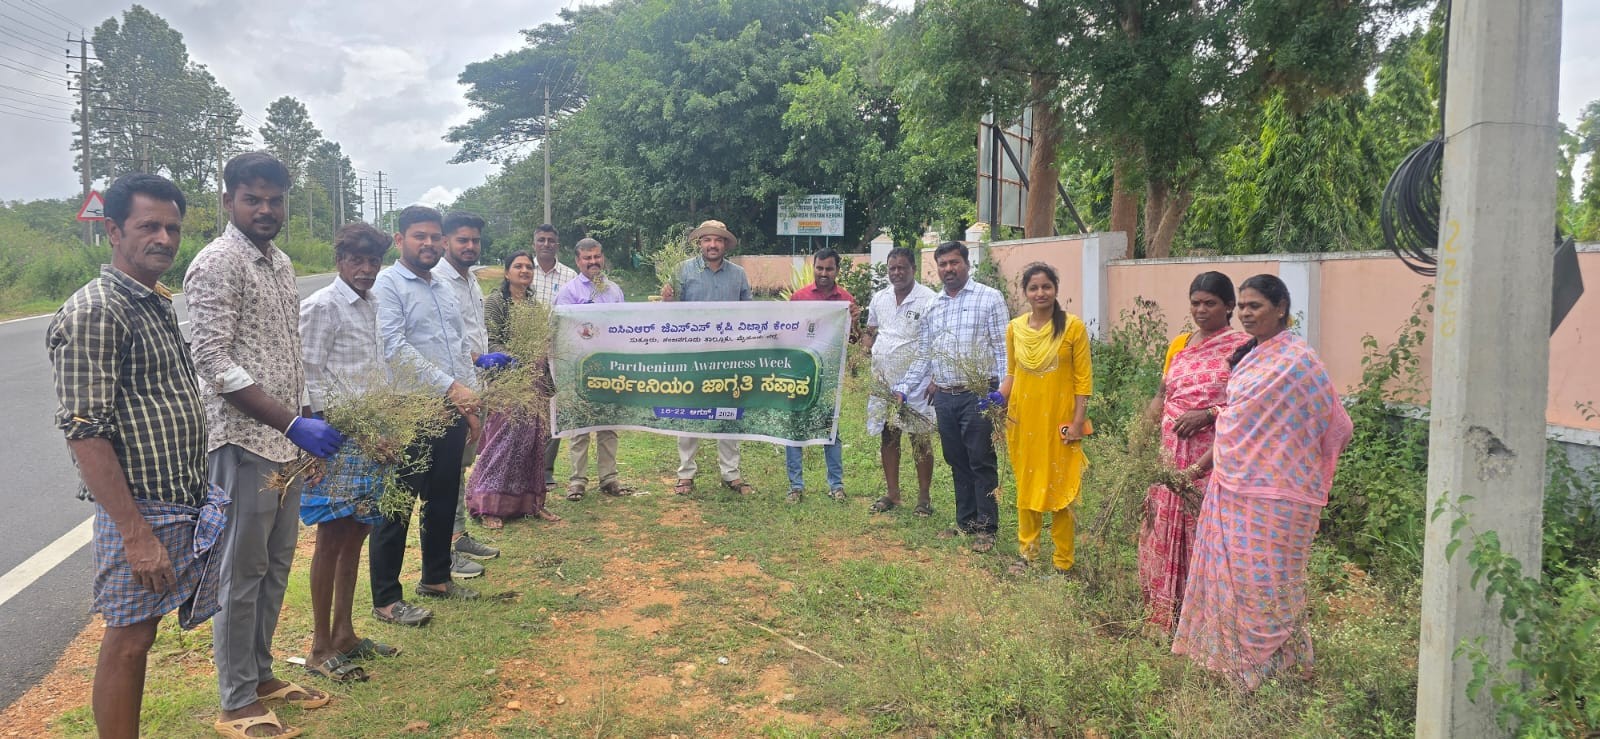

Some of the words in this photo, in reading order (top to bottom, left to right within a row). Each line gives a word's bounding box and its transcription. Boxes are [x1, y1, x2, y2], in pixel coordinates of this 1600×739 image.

[716, 322, 733, 335] ಕೃಷಿ
[738, 321, 769, 333] ವಿಜ್ಞಾನ
[773, 320, 800, 331] ಕೇಂದ್ರ
[610, 360, 687, 373] Parthenium
[692, 359, 756, 372] Awareness
[759, 357, 792, 370] Week
[701, 373, 753, 399] ಜಾಗೃತಿ
[761, 372, 810, 399] ಸಪ್ತಾಹ
